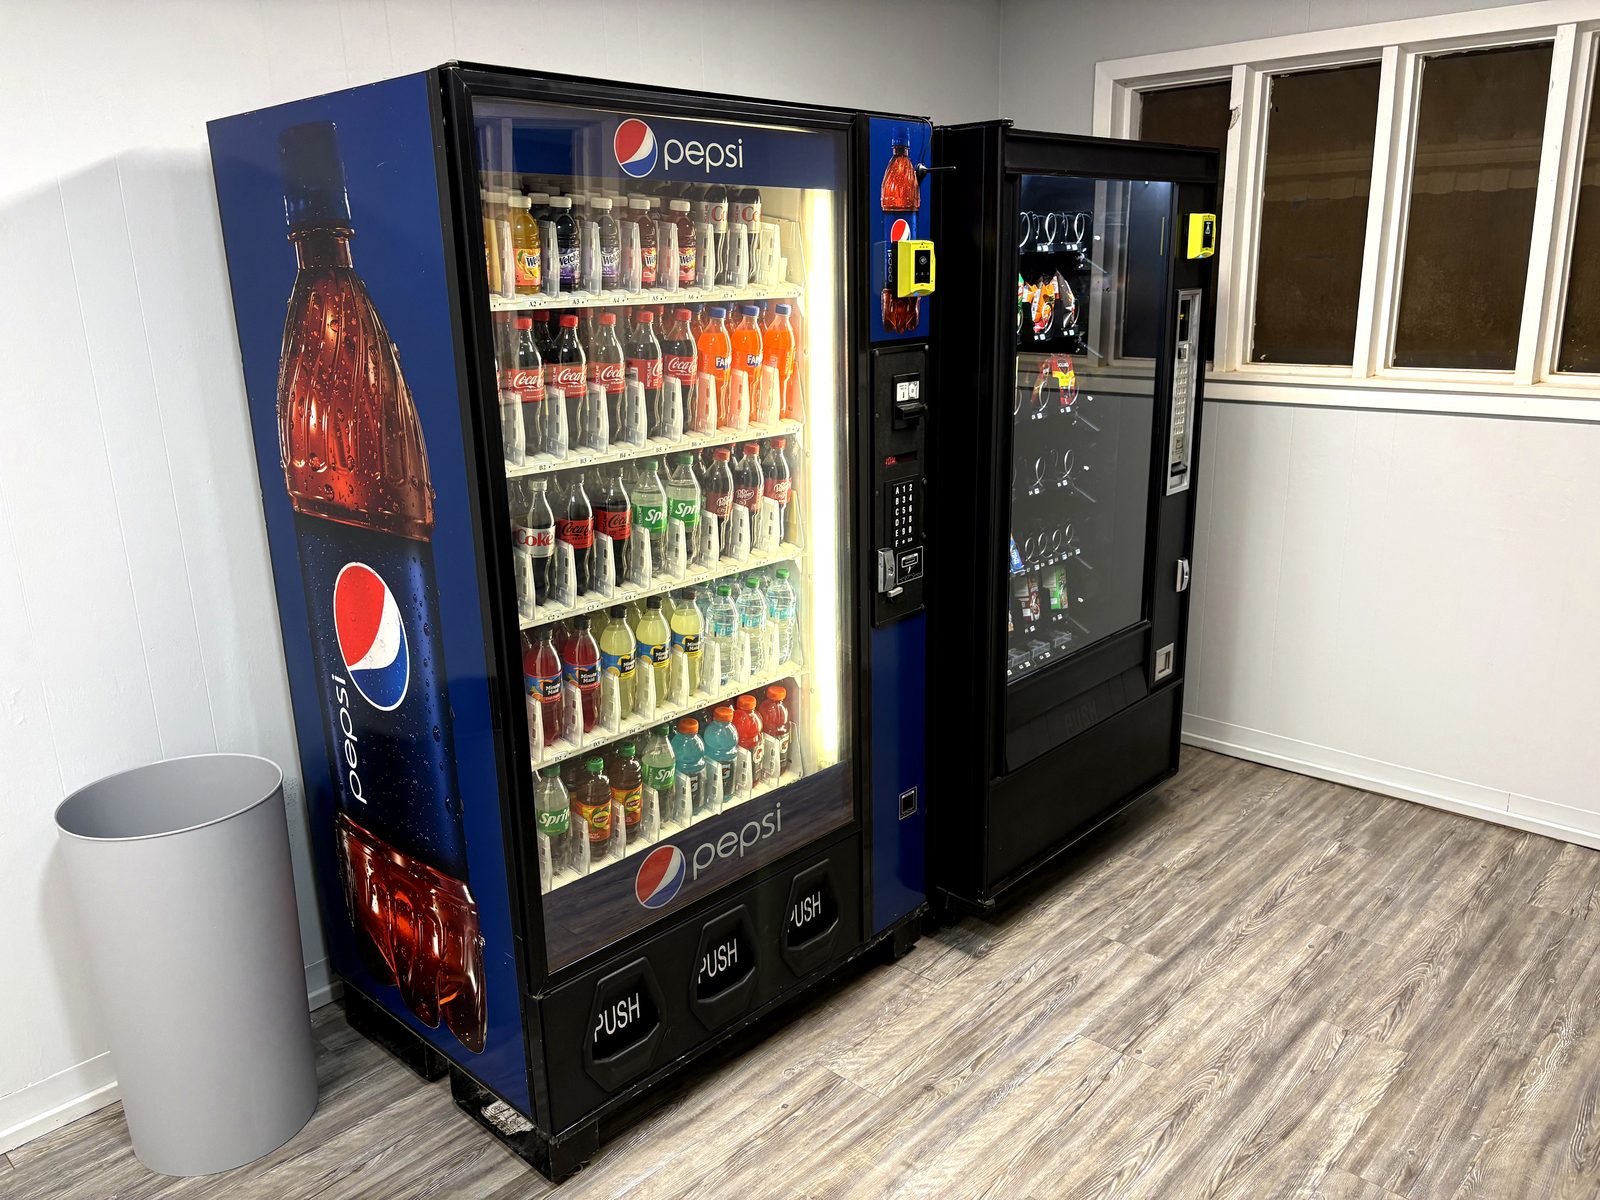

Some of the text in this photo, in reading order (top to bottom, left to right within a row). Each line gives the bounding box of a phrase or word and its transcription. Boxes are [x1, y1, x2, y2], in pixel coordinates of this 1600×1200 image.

[664, 138, 743, 173] pepsi
[517, 528, 554, 547] Coke
[332, 674, 367, 804] pepsi
[1065, 699, 1097, 736] PUSH
[692, 802, 782, 880] pepsi
[594, 992, 640, 1042] PUSH
